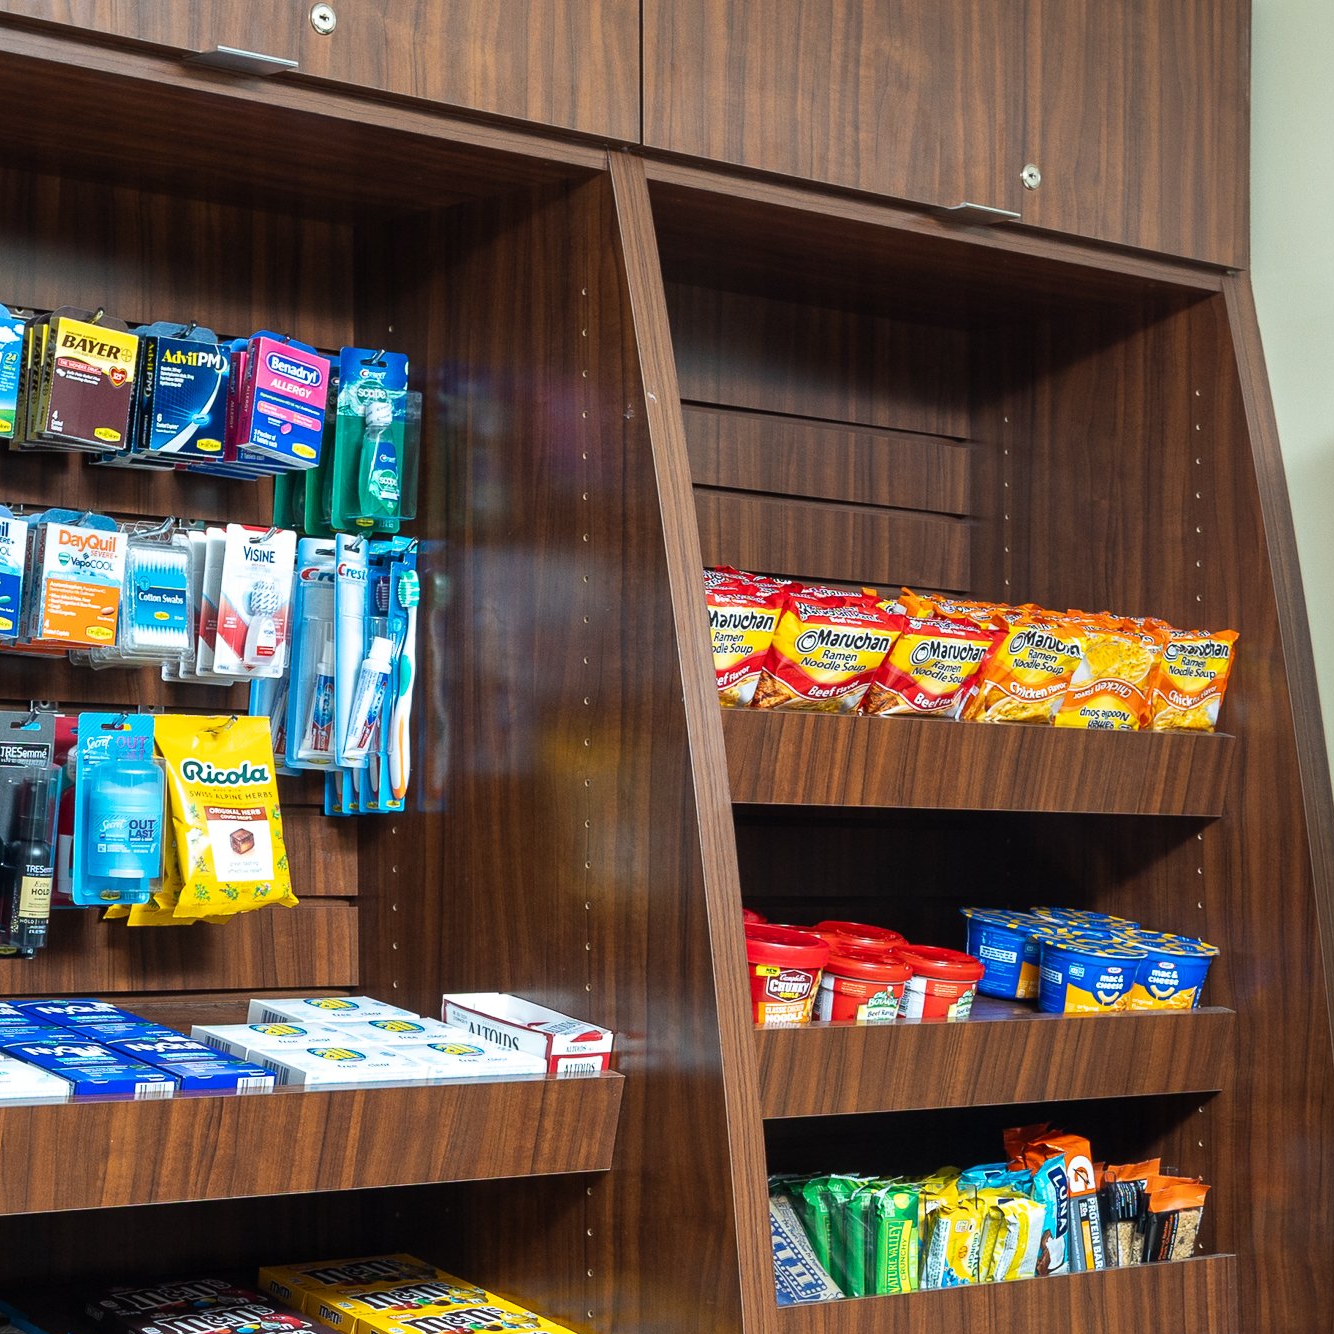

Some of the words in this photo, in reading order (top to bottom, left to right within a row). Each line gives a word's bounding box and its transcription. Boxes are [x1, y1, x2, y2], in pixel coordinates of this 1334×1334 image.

[61, 333, 122, 361] BAYER
[6, 351, 17, 361] 24
[271, 354, 318, 386] Benadryl
[270, 378, 312, 399] ALLERGY
[357, 387, 388, 400] scope
[58, 529, 117, 553] DayQuil
[243, 545, 276, 564] VISINE
[138, 591, 161, 602] Cotton
[162, 594, 184, 605] Swabs
[817, 629, 890, 652] Maruchan
[822, 650, 857, 662] Ramen
[1028, 649, 1057, 663] Ramen
[1180, 656, 1206, 669] Ramen
[800, 657, 842, 671] Noodle
[843, 662, 866, 673] Soup
[1012, 658, 1040, 671] Noodle
[1040, 661, 1064, 675] Soup
[1192, 668, 1216, 680] Soup
[808, 683, 836, 698] Beef
[835, 679, 860, 695] Flavor
[1009, 681, 1047, 700] Chicken
[1047, 682, 1067, 696] Flavor
[0, 745, 48, 759] TRESemmé
[182, 760, 269, 785] Ricola
[189, 790, 213, 799] SWISS
[215, 791, 243, 801] ALPINE
[244, 790, 273, 800] HERBS
[208, 806, 241, 817] ORIGINAL
[241, 808, 261, 817] HERB
[128, 819, 156, 830] OUT
[128, 829, 155, 839] LAST
[31, 887, 51, 896] HOLD
[769, 981, 810, 995] CHUNKY
[1052, 1173, 1068, 1232] LUNA
[1087, 1197, 1102, 1243] PROTEIN
[899, 1238, 907, 1281] CRUNCHY
[1092, 1243, 1103, 1269] BAR
